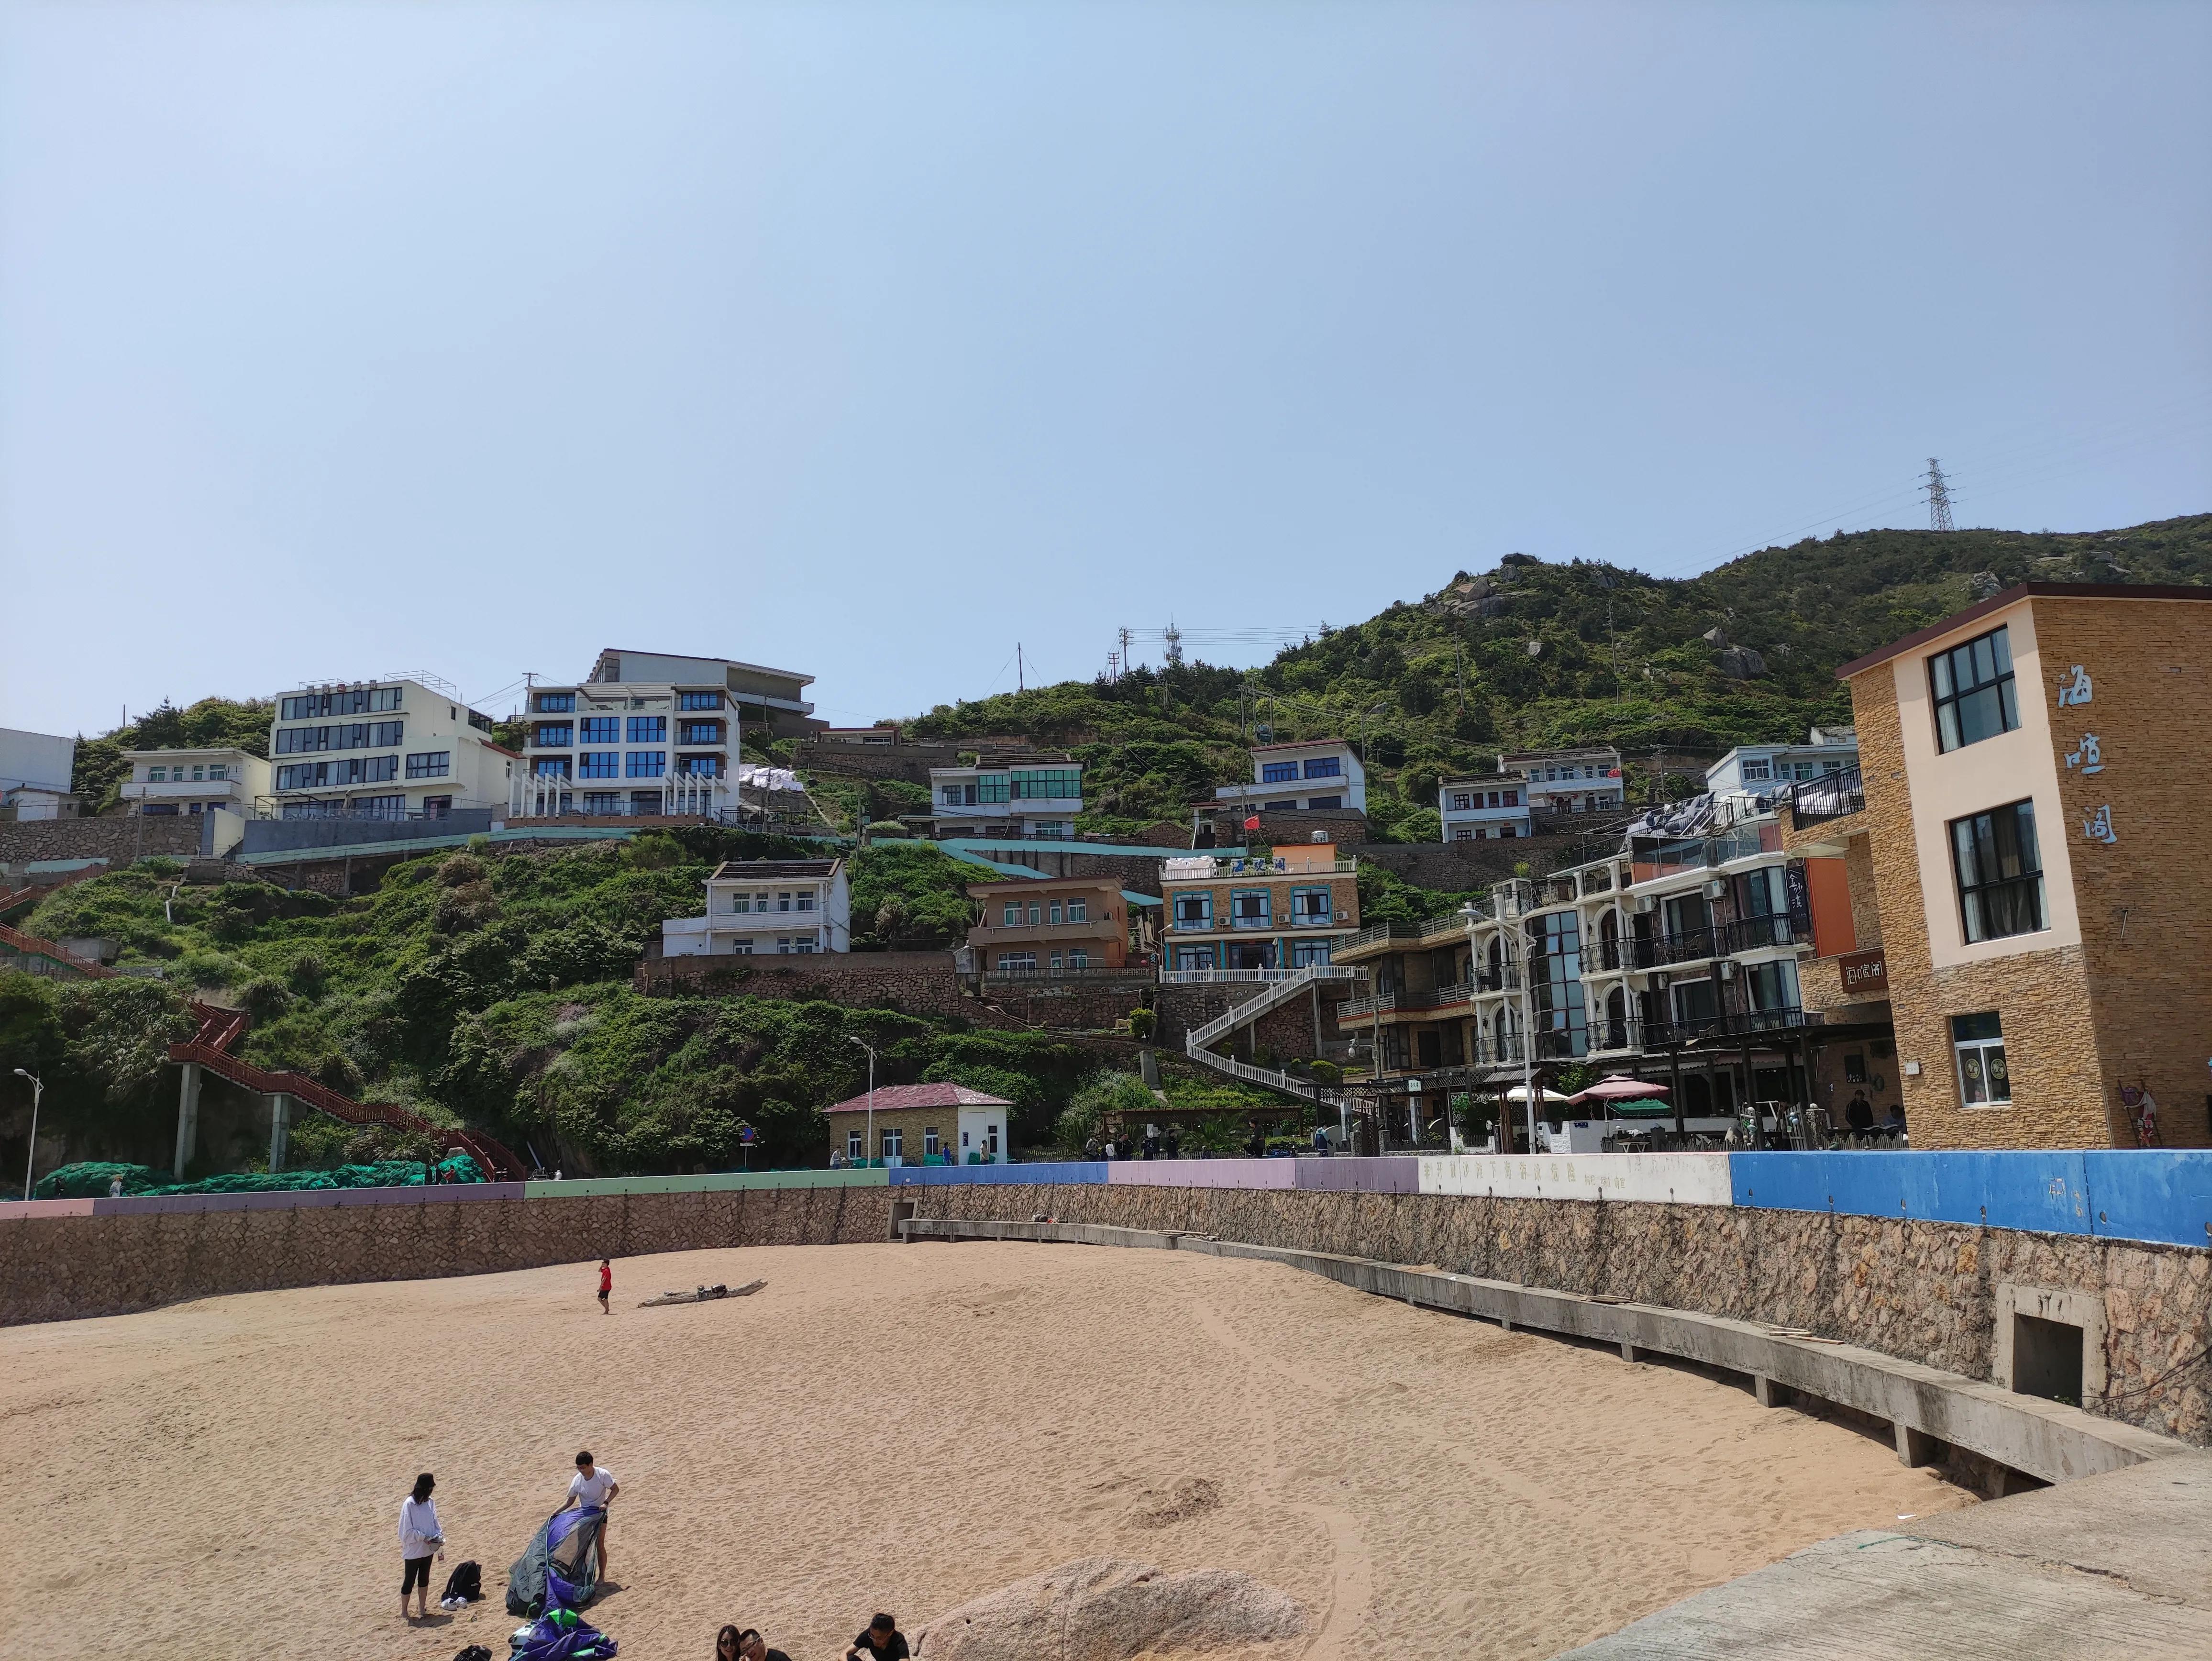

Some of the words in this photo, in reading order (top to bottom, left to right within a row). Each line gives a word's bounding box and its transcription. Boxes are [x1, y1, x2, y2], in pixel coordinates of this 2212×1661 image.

[2058, 664, 2117, 843] 海喧阁
[1846, 961, 1883, 986] 海喧阁
